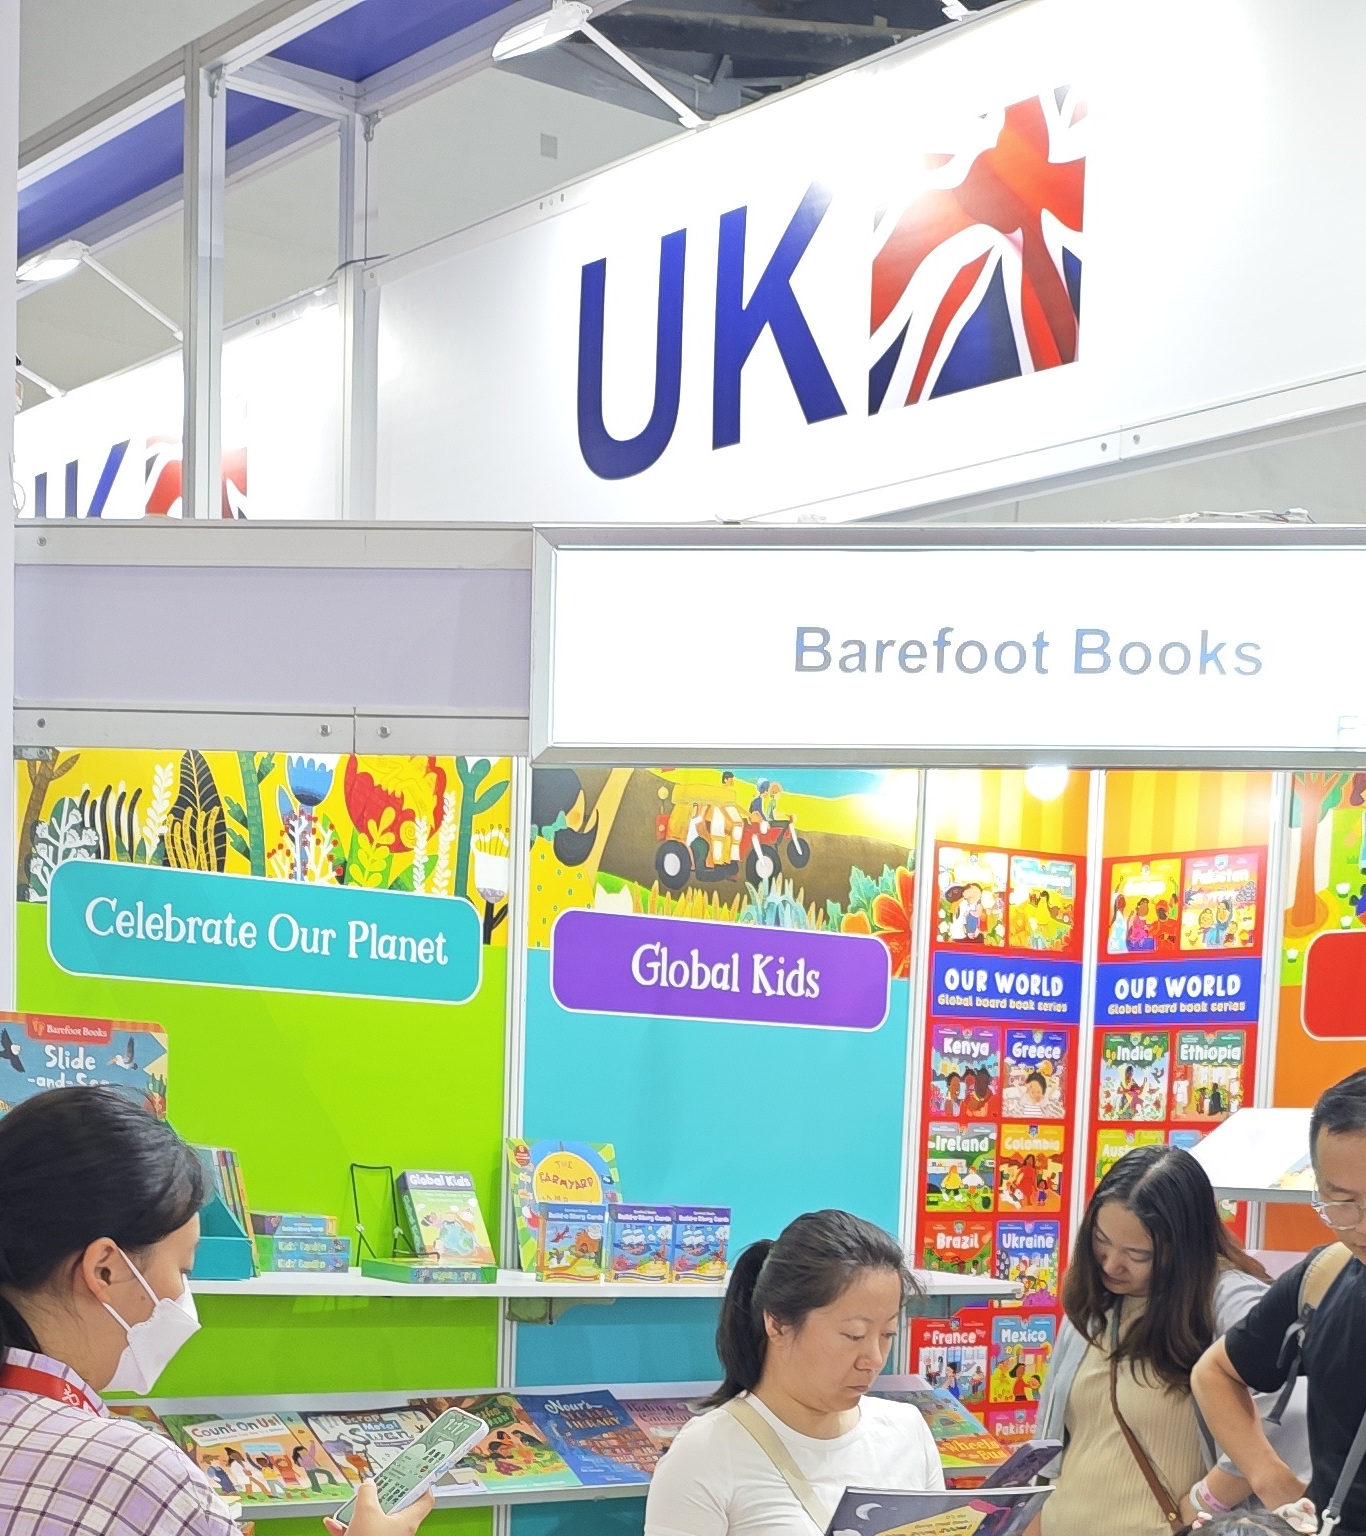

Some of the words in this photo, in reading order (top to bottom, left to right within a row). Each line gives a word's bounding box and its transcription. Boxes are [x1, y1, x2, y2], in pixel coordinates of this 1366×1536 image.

[577, 181, 848, 480] UK
[794, 626, 1050, 674] Barefoot
[1073, 627, 1263, 677] Books
[84, 896, 256, 949] Celebrate
[267, 913, 337, 956] Our
[347, 920, 448, 966] Planet
[631, 941, 741, 993] Global
[751, 947, 822, 999] Kids
[944, 967, 988, 992] OUR
[994, 972, 1064, 997] WORLD
[1114, 976, 1158, 1000] OUR
[1164, 974, 1241, 998] WORLD
[937, 993, 973, 1006] Global
[1107, 1002, 1143, 1015] Global
[46, 1024, 81, 1037] Barefoot
[82, 1027, 108, 1039] Books
[943, 1037, 990, 1058] Kenya
[1012, 1042, 1061, 1060] Greece
[1116, 1045, 1153, 1062] India
[1180, 1043, 1242, 1064] Ethiopia
[44, 1045, 96, 1071] Slide
[935, 1135, 989, 1153] Ireland
[1005, 1136, 1060, 1152] Colombia
[409, 1174, 444, 1186] Global
[445, 1175, 472, 1188] Kids
[936, 1232, 979, 1250] Brazil
[1002, 1233, 1054, 1249] Ukraine
[932, 1330, 976, 1345] France
[1001, 1329, 1047, 1344] Mexico
[544, 1400, 604, 1415] Nour's
[191, 1423, 235, 1439] Count
[236, 1419, 255, 1432] On
[256, 1415, 282, 1429] Us!
[340, 1414, 382, 1425] Scrap
[362, 1420, 399, 1432] Metal
[442, 1418, 470, 1436] 1:17
[349, 1428, 414, 1446] Swan
[945, 1439, 1000, 1453] Wheels
